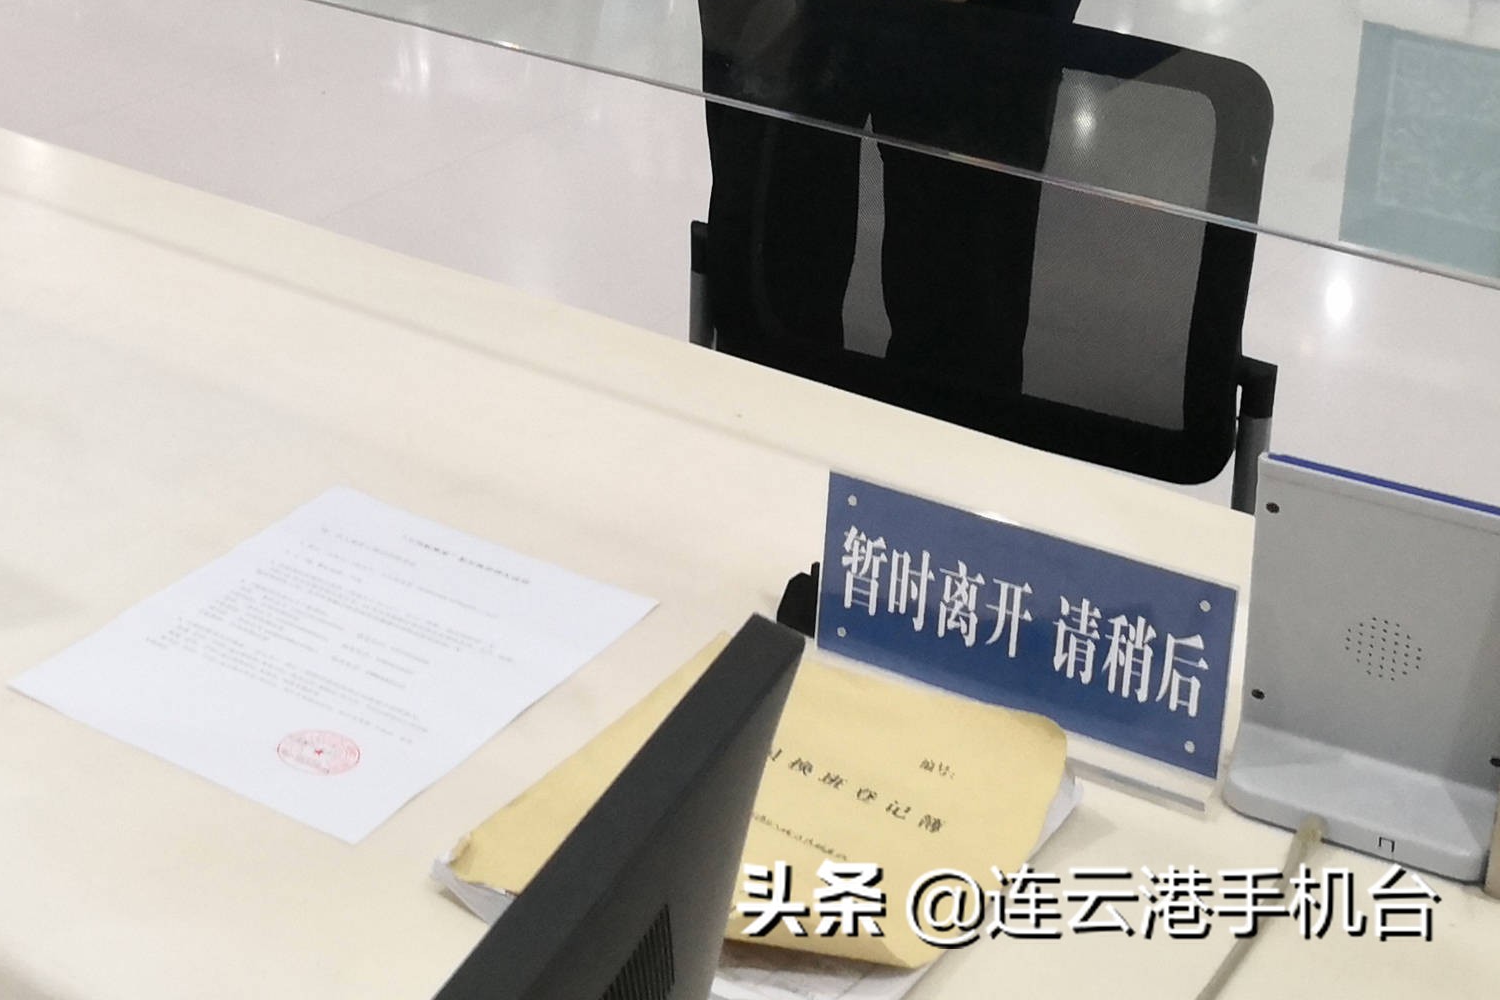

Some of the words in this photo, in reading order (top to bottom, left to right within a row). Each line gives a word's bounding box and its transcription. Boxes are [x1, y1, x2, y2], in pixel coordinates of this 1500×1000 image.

[841, 525, 1035, 659] 暂时离开
[1052, 595, 1210, 719] 请稍后
